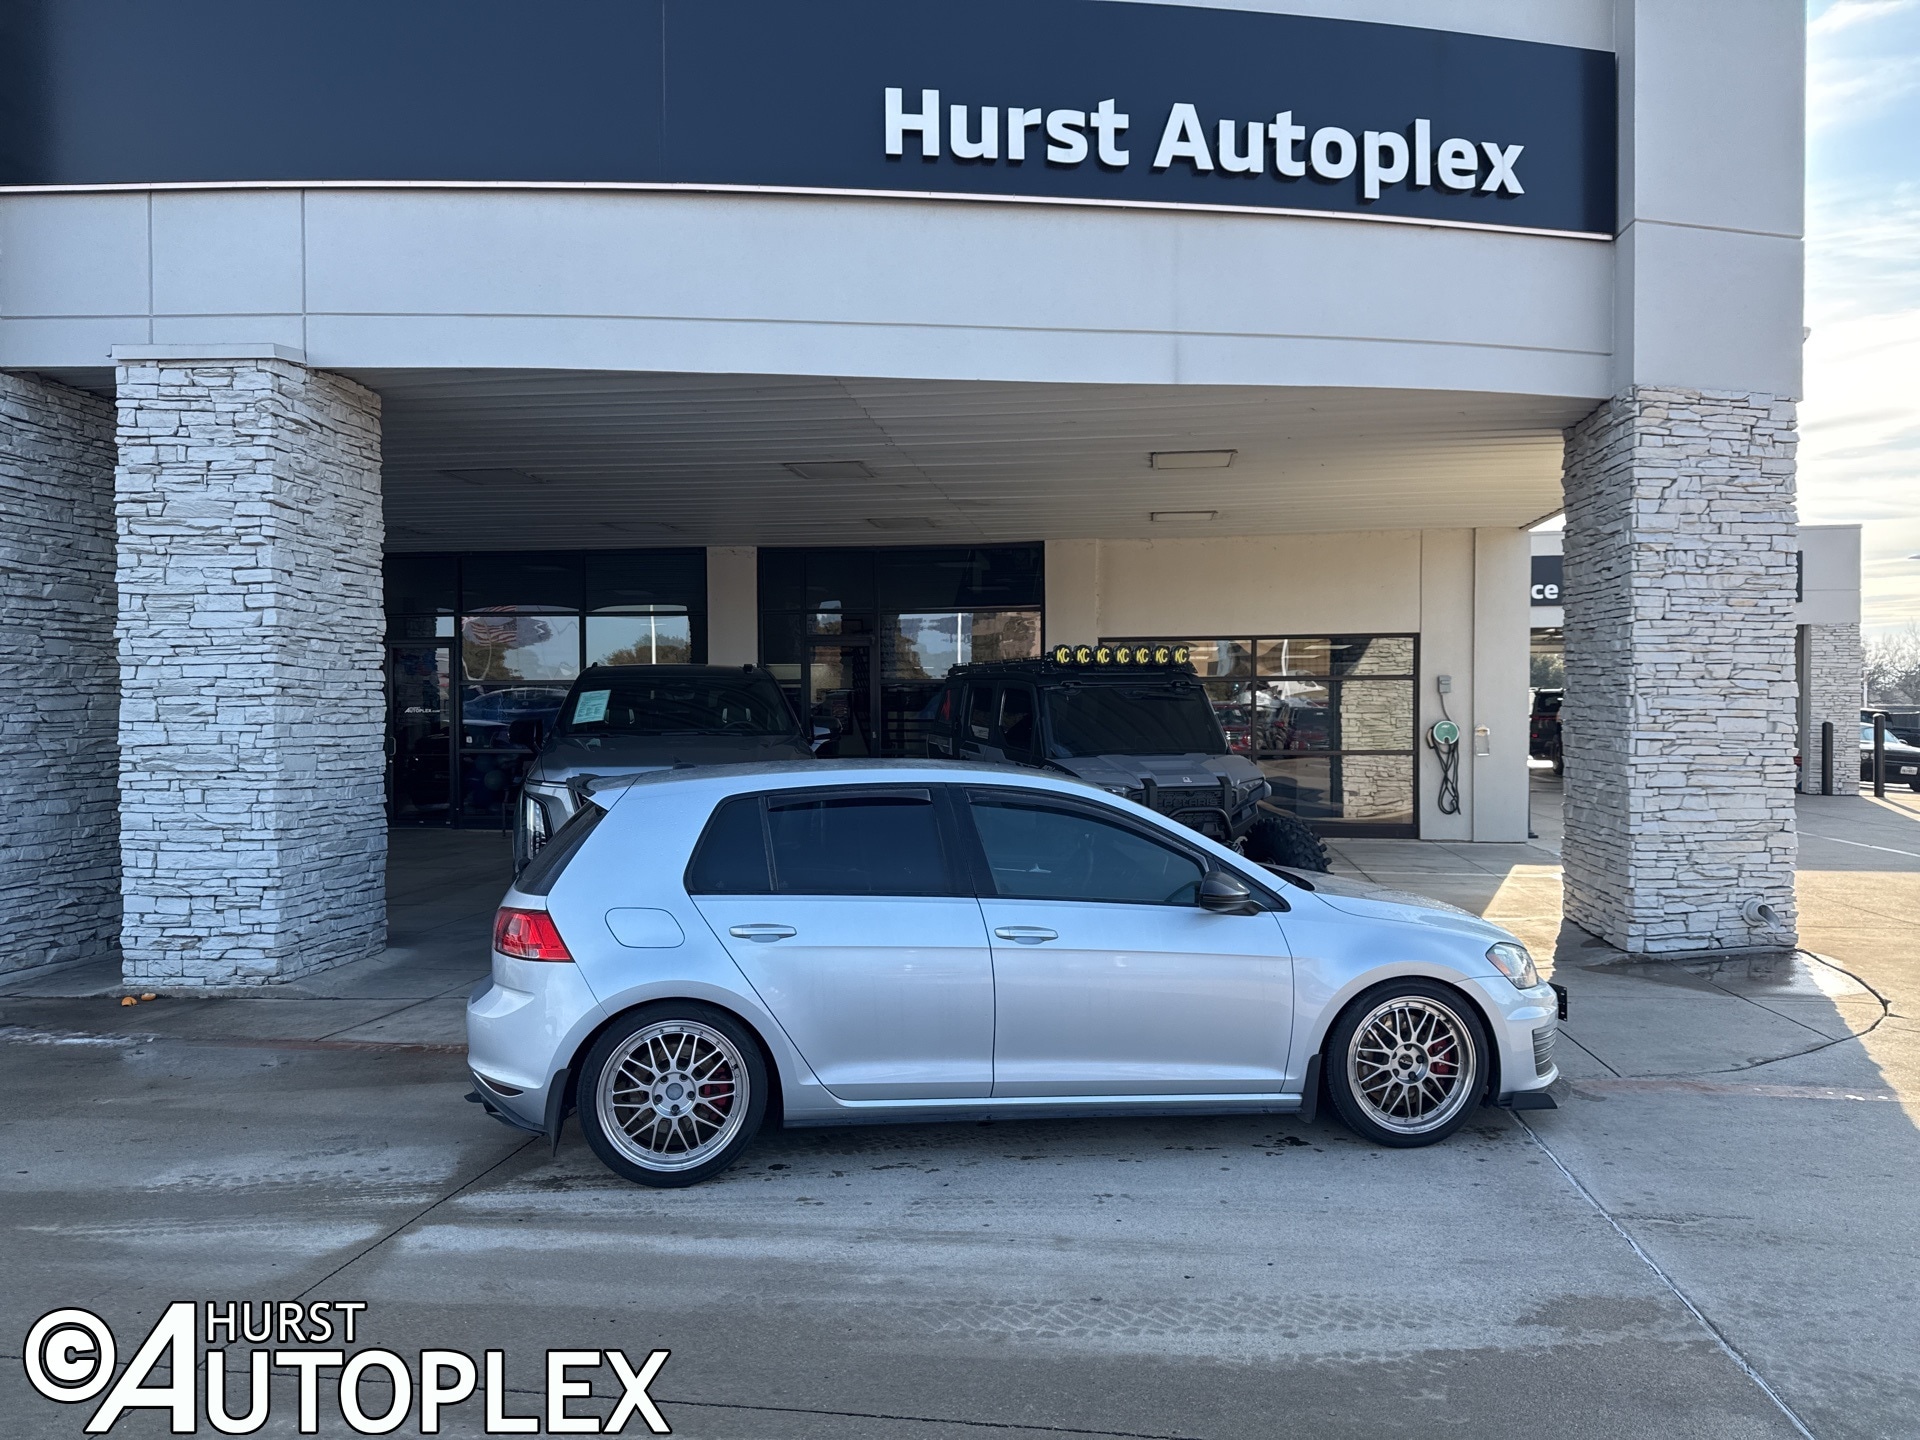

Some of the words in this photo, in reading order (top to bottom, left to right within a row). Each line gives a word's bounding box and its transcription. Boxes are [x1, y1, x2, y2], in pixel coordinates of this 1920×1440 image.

[885, 87, 1129, 167] Hurst
[1154, 102, 1525, 199] Autoplex
[1057, 647, 1070, 663] KC
[1077, 647, 1090, 663] KC
[1097, 647, 1110, 663] KC
[1117, 647, 1130, 663] KC
[1136, 647, 1149, 663] KC
[1155, 647, 1168, 663] KC
[1175, 647, 1187, 663] KC
[1163, 798, 1218, 807] POLARIS
